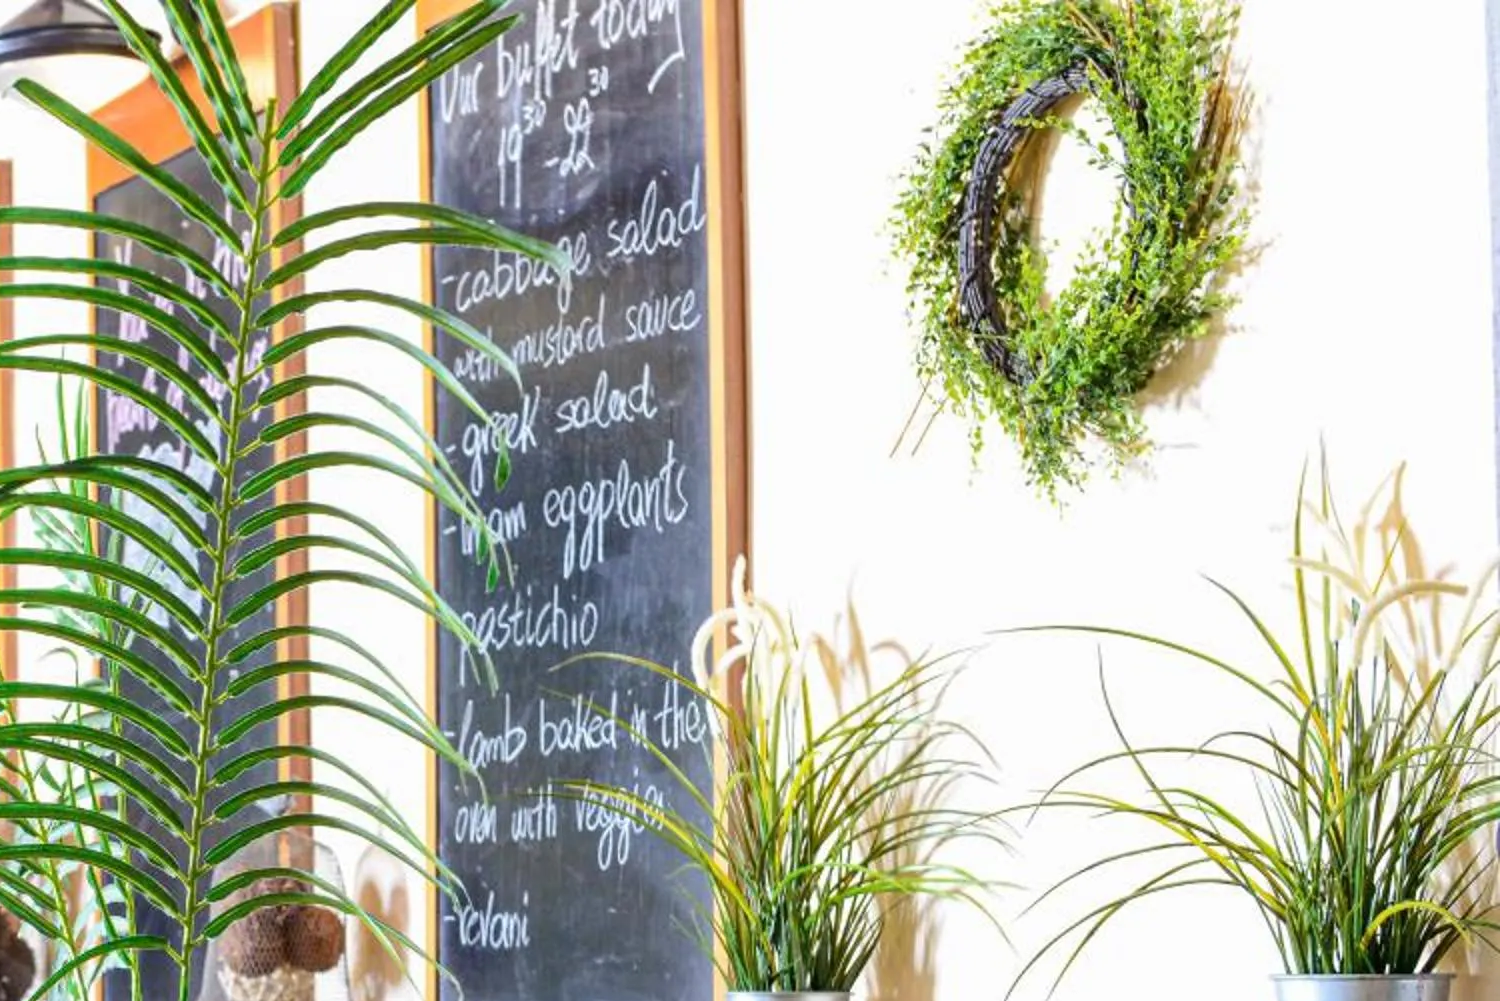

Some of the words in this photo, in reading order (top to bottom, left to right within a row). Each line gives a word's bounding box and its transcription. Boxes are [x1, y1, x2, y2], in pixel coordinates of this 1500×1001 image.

[606, 163, 707, 257] salad
[511, 291, 607, 369] mustard
[624, 288, 703, 342] sauce
[555, 362, 658, 434] salad
[543, 439, 689, 580] eggplants
[459, 584, 599, 688] pastichio
[539, 690, 619, 756] baked
[630, 688, 650, 750] in
[653, 659, 707, 751] the
[454, 800, 498, 844] oven
[511, 783, 558, 842] with
